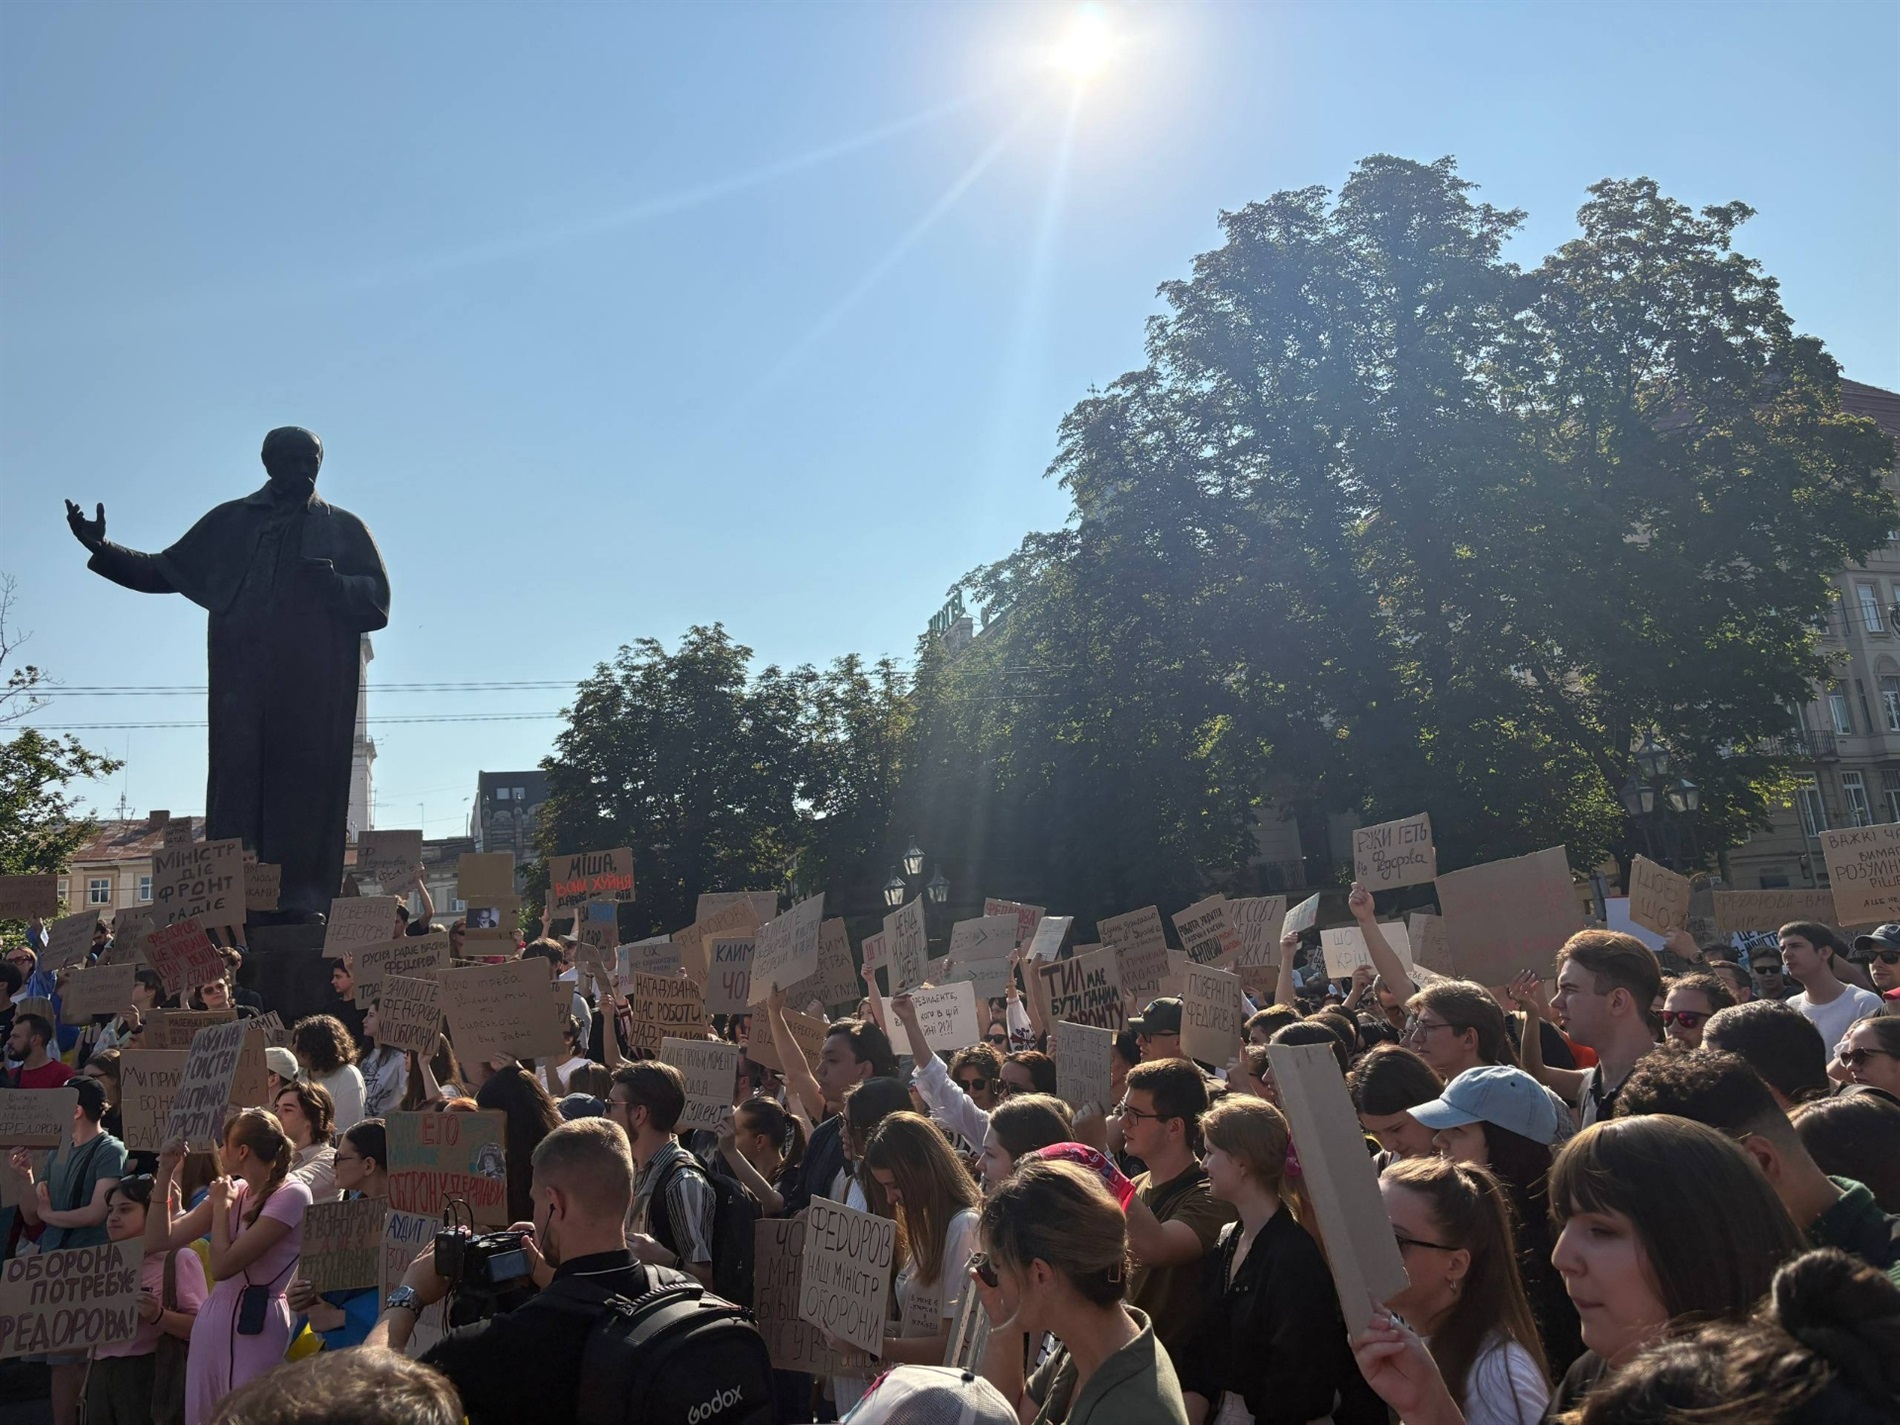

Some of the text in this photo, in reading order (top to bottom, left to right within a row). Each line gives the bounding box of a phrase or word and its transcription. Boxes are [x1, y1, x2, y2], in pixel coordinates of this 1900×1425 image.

[1398, 823, 1427, 845] ГЕТЬ
[1828, 829, 1900, 849] ВАЖКІ ЧА
[155, 842, 235, 874] МІНІСТР
[1372, 848, 1428, 880] Федорова
[1859, 845, 1900, 862] ВИМАГ
[176, 863, 214, 883] ДІЄ
[555, 872, 633, 897] ВОНИ ХУЙНЯ
[1835, 859, 1900, 883] РОЗУМН
[158, 876, 233, 903] ФРОНТ
[169, 898, 225, 922] РАДІЄ
[332, 904, 391, 921] ПОВЕРНІТЬ
[1247, 900, 1277, 923] СОБІ
[147, 919, 198, 948] ФЕДОРОВ
[715, 944, 756, 963] КЛИМ
[385, 978, 440, 1003] ЗАЛИШТЕ
[722, 970, 751, 1000] ЧО
[1040, 958, 1087, 998] ТИЛ
[1086, 968, 1107, 989] МАЄ
[1189, 973, 1240, 1008] ПОВЕРНІТЬ
[383, 998, 441, 1030] ФЕДОРОВА
[635, 999, 701, 1024] ЧАС РОБОТИ
[1052, 995, 1082, 1017] БУТИ
[1186, 1001, 1236, 1034] ФЕДОРОВА
[631, 1022, 658, 1046] НАД
[122, 1066, 182, 1088] МИ ПРИЙ
[140, 1094, 158, 1112] БО
[422, 1114, 460, 1147] ЕГО
[388, 1171, 448, 1214] ОБОРОНУ
[448, 1174, 505, 1212] ДЕРЖАВИ
[386, 1213, 426, 1243] АУДИТ
[776, 1221, 805, 1259] ЧО
[7, 1243, 123, 1284] ОБОРОНА
[768, 1256, 799, 1287] МІН
[808, 1254, 829, 1286] НАШ
[807, 1286, 881, 1347] ОБОРОНИ
[688, 1385, 744, 1425] Godox
